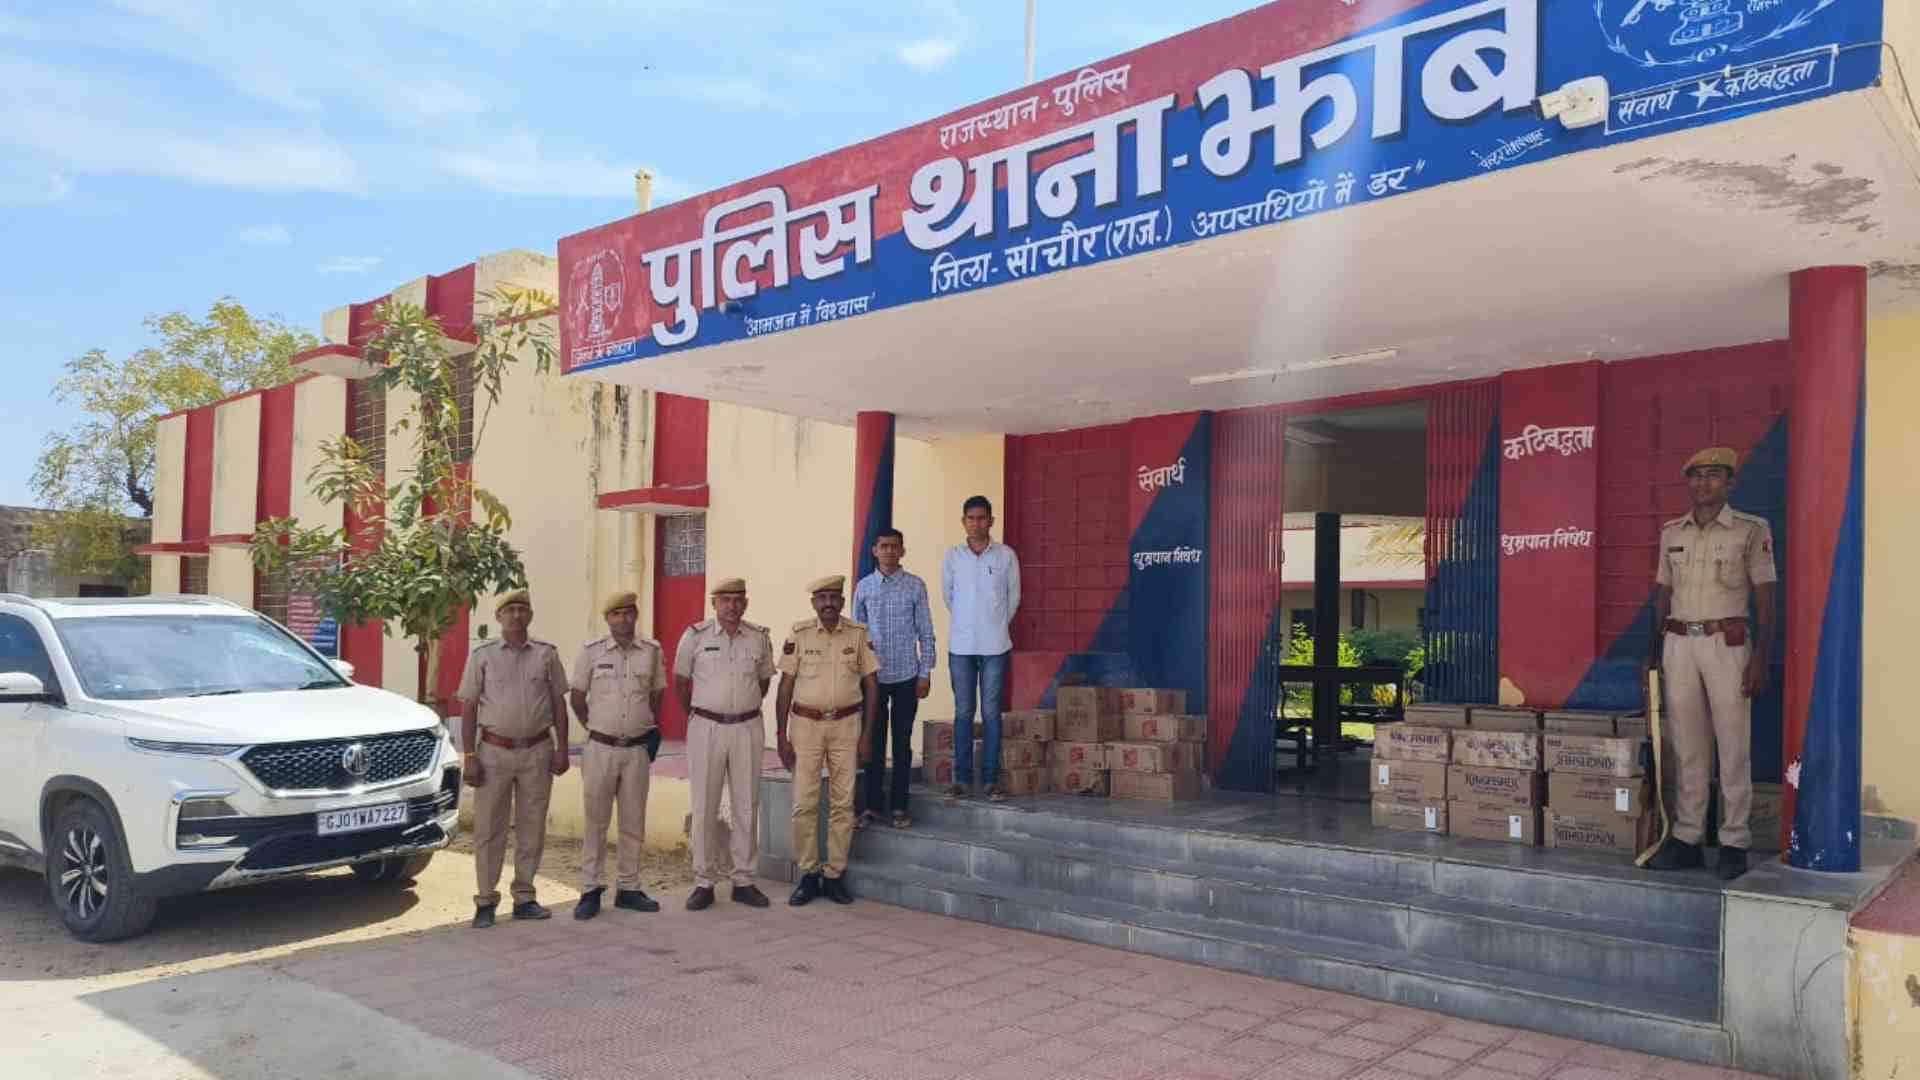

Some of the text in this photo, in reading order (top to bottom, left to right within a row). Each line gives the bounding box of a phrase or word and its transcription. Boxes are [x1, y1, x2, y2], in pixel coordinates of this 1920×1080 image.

[1191, 180, 1328, 236] अपराधियों
[1335, 172, 1356, 205] में
[640, 186, 879, 347] पुलिस
[1503, 424, 1595, 461] कटिबद्धता
[1138, 457, 1186, 492] सेवार्थ
